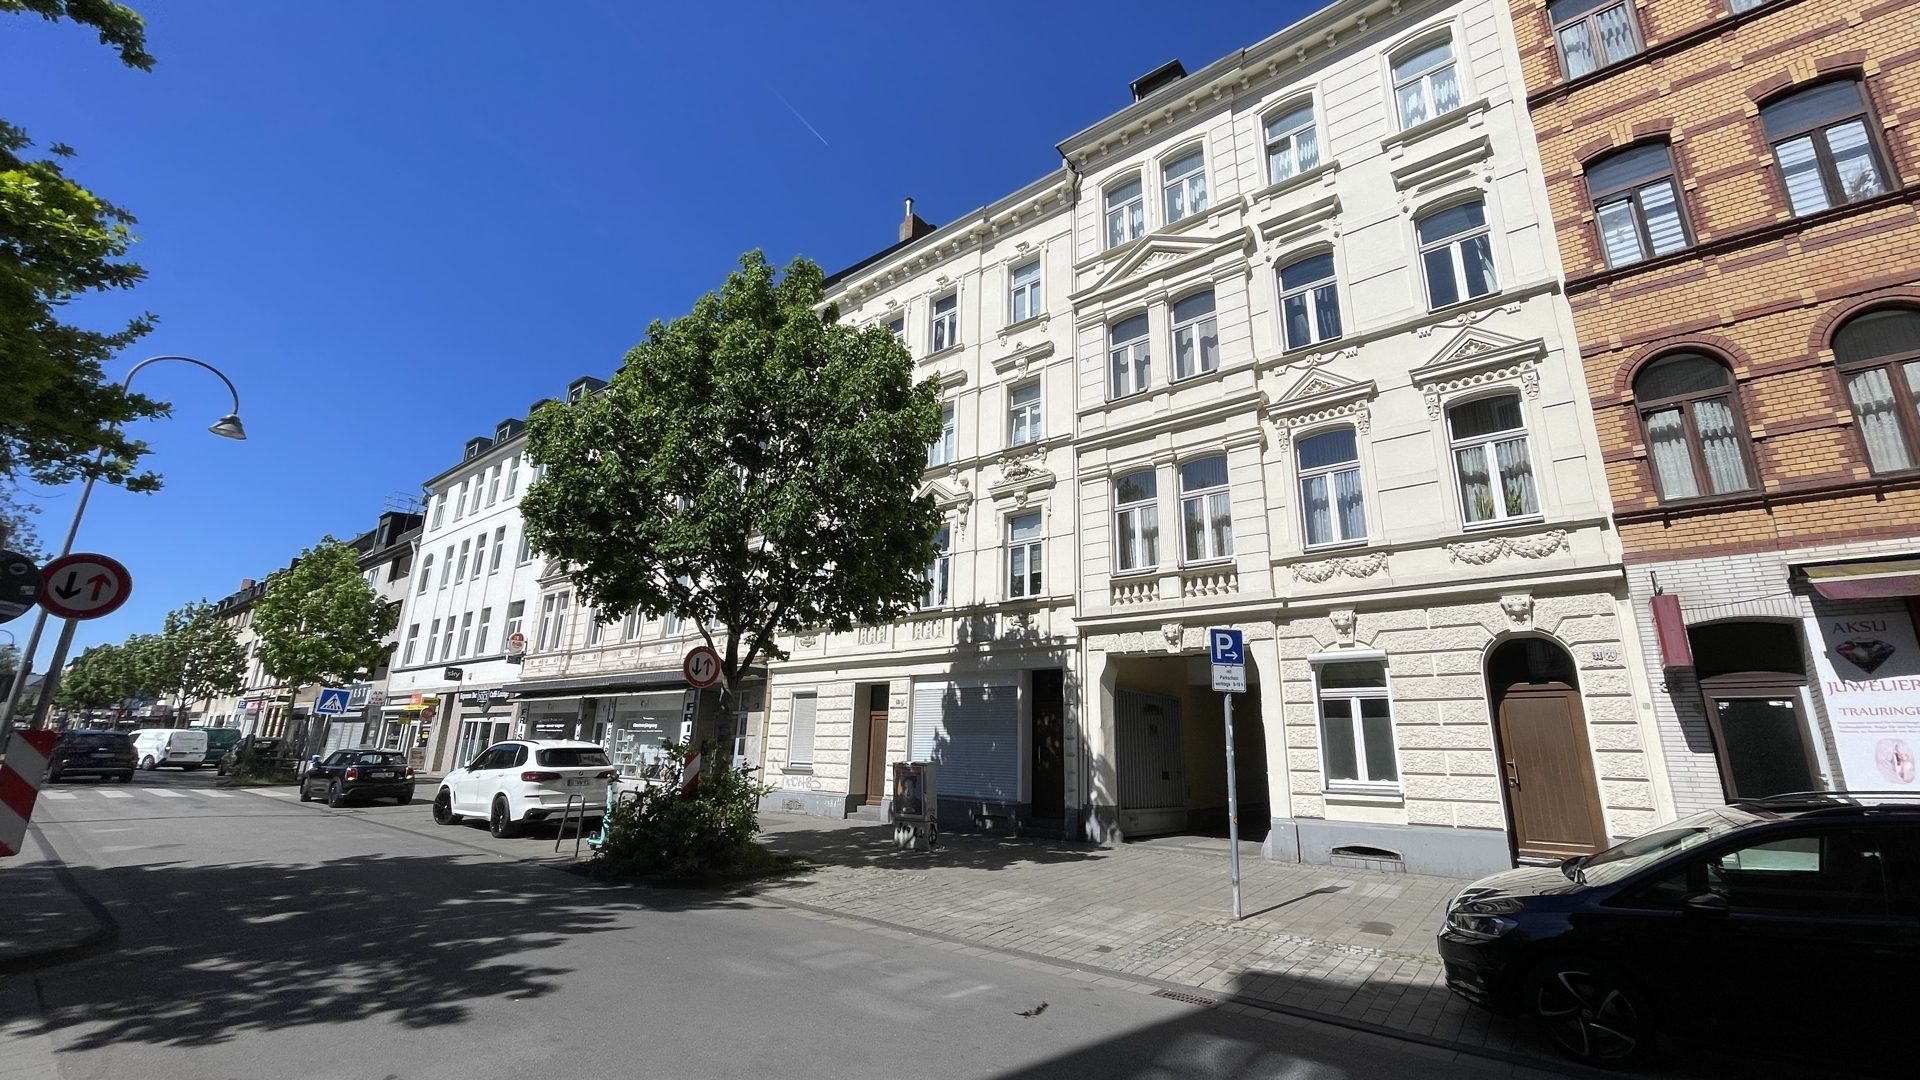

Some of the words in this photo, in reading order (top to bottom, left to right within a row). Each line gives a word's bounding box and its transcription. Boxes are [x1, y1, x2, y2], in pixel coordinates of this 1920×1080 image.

[1832, 620, 1888, 635] AKSU
[1215, 633, 1234, 660] P
[447, 670, 460, 678] sky
